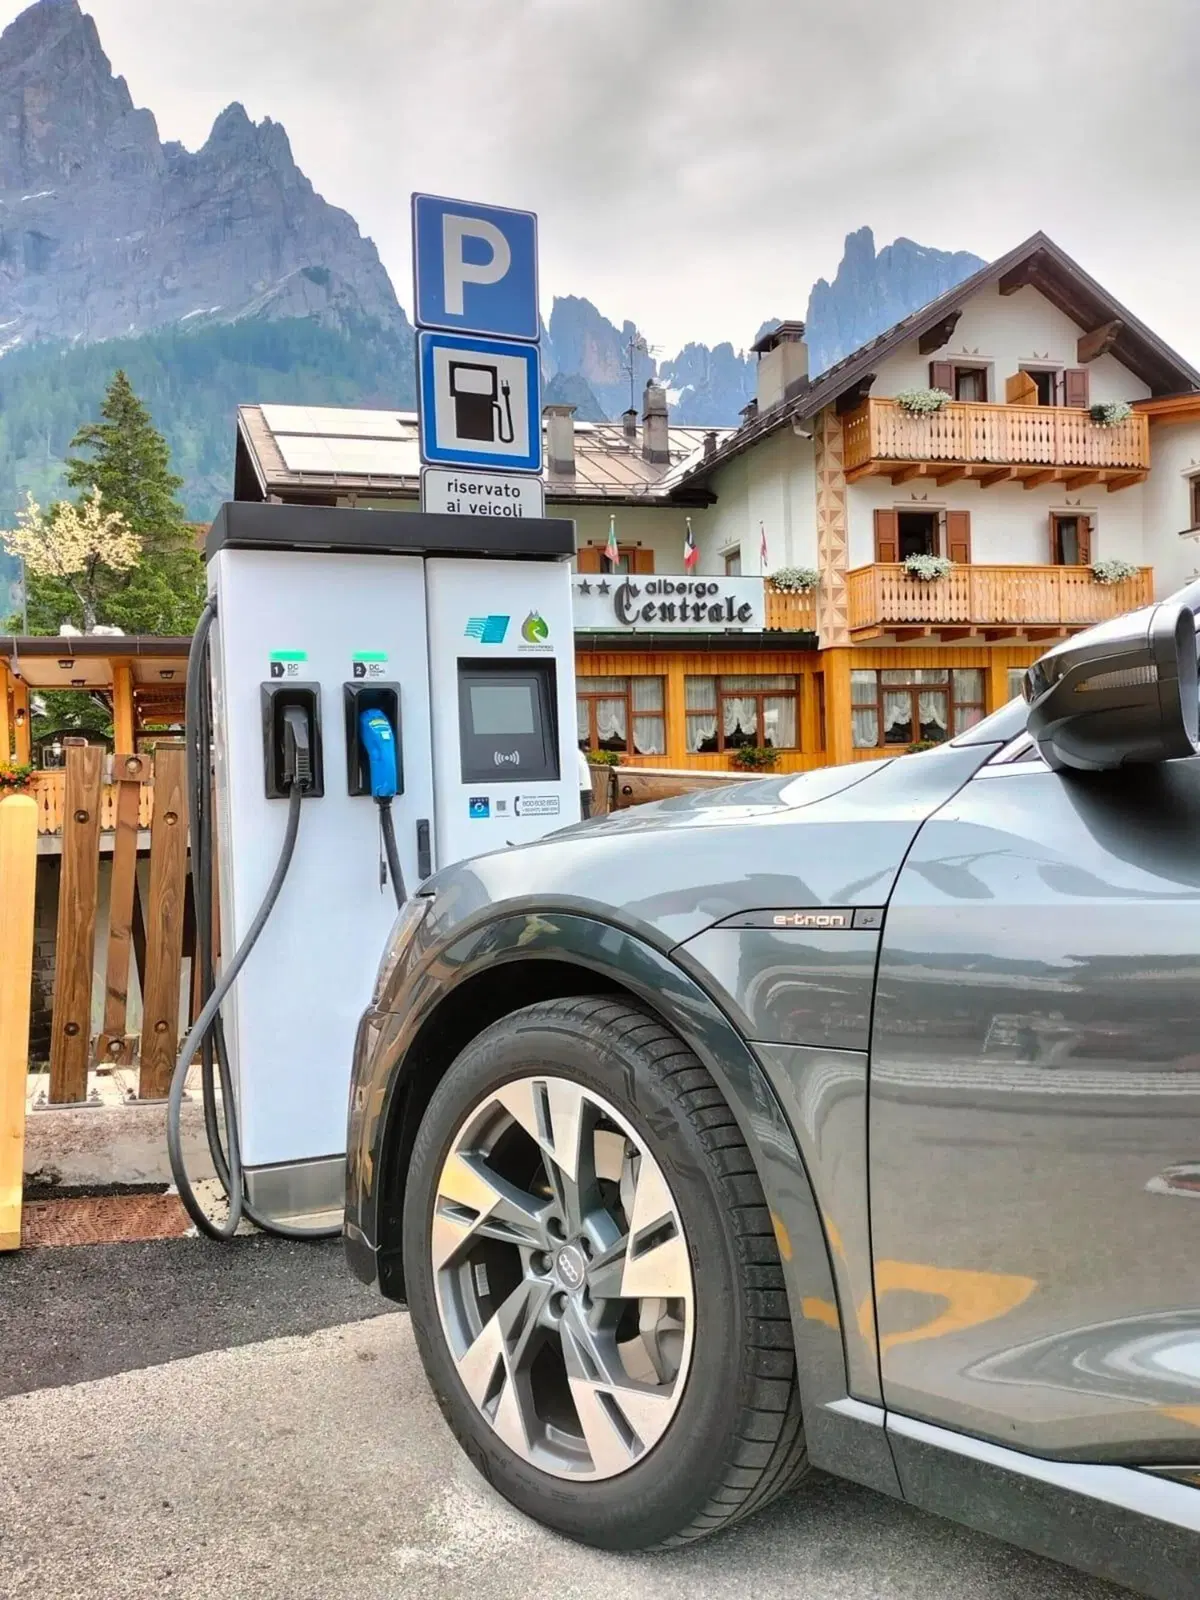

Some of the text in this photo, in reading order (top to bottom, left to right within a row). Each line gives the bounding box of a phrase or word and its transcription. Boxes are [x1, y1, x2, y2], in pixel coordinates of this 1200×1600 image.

[442, 213, 512, 316] P
[447, 478, 521, 498] riservato
[446, 498, 523, 517] ai veicoli
[645, 579, 719, 598] albergo
[613, 576, 753, 625] Centrale
[773, 913, 845, 926] e-tron
